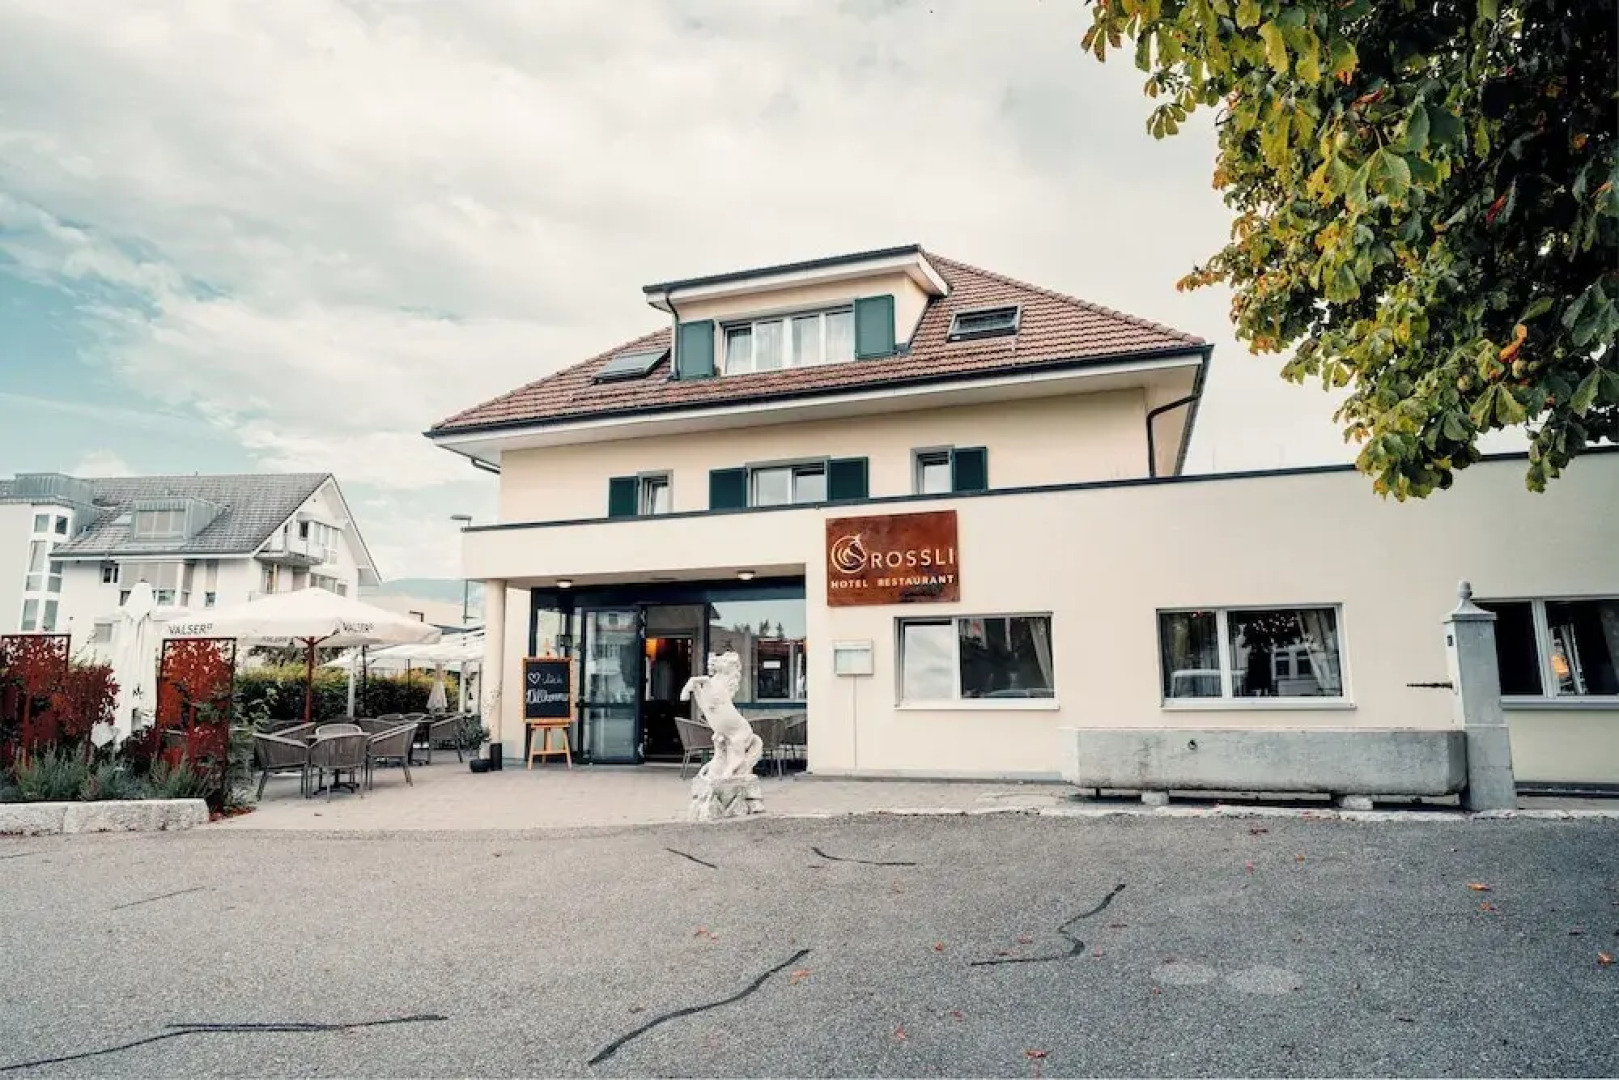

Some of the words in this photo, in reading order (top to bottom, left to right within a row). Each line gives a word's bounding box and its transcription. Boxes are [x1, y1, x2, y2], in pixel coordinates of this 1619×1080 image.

[870, 547, 954, 569] ROSSLI
[831, 579, 868, 589] HOTEL
[877, 574, 954, 587] RESTAURANT
